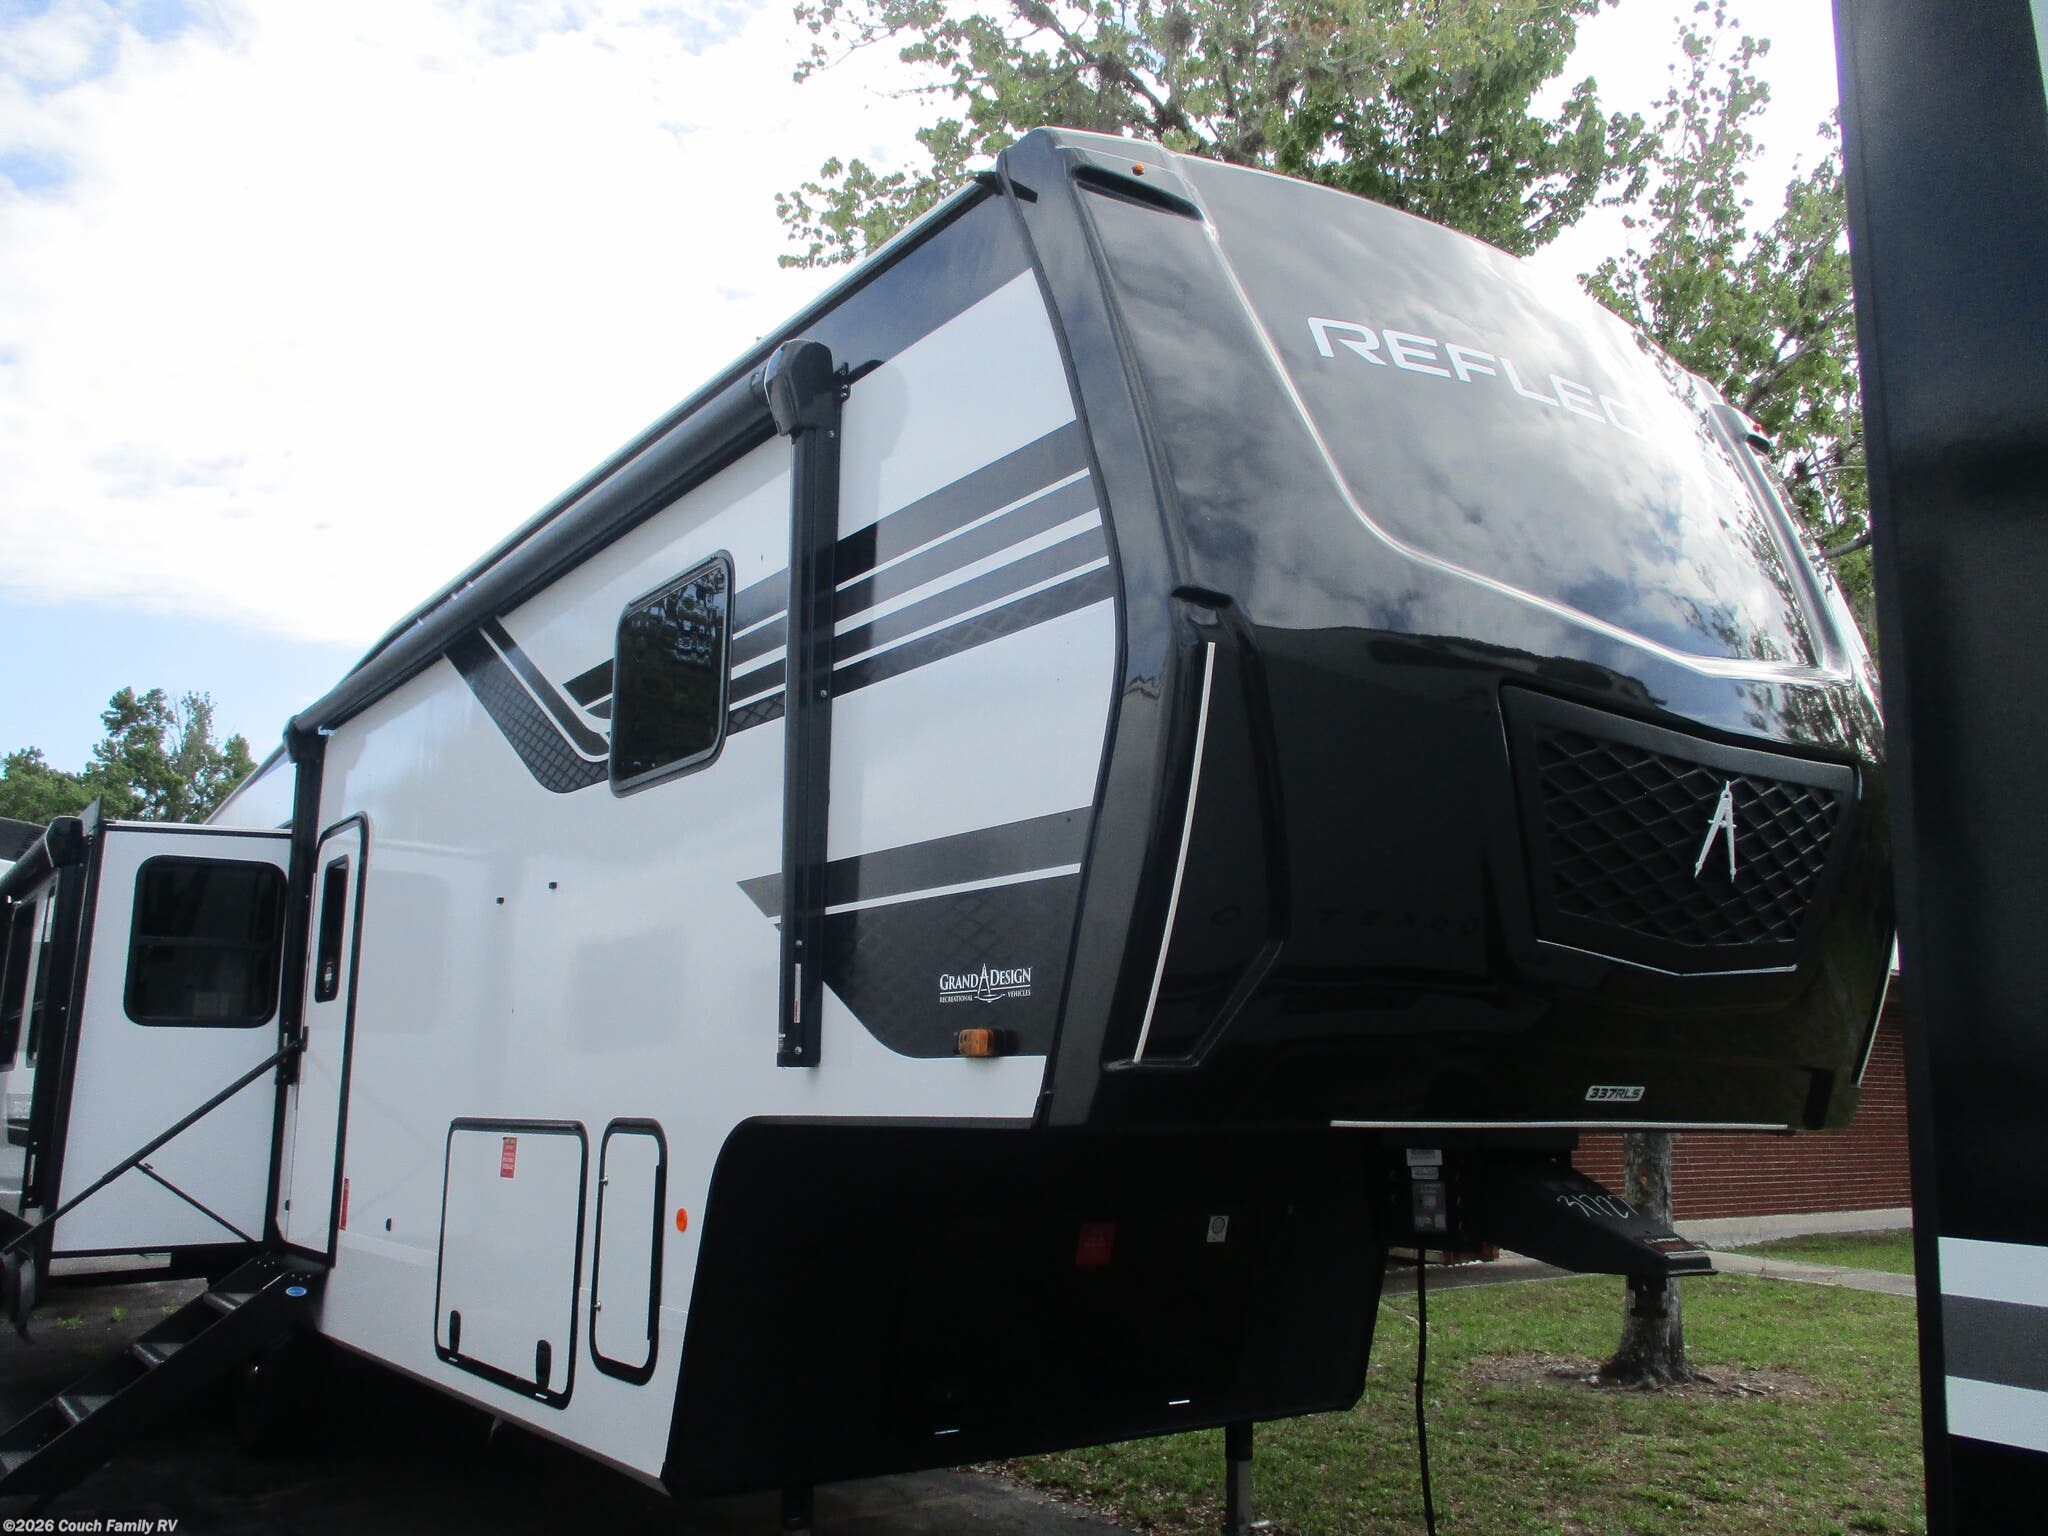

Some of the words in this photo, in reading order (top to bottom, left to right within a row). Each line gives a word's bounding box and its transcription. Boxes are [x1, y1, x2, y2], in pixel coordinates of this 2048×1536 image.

[940, 973, 979, 991] GRAND
[990, 967, 1032, 986] DESIGN
[1007, 988, 1031, 998] VEHICLES
[1589, 1087, 1641, 1099] 337RLS
